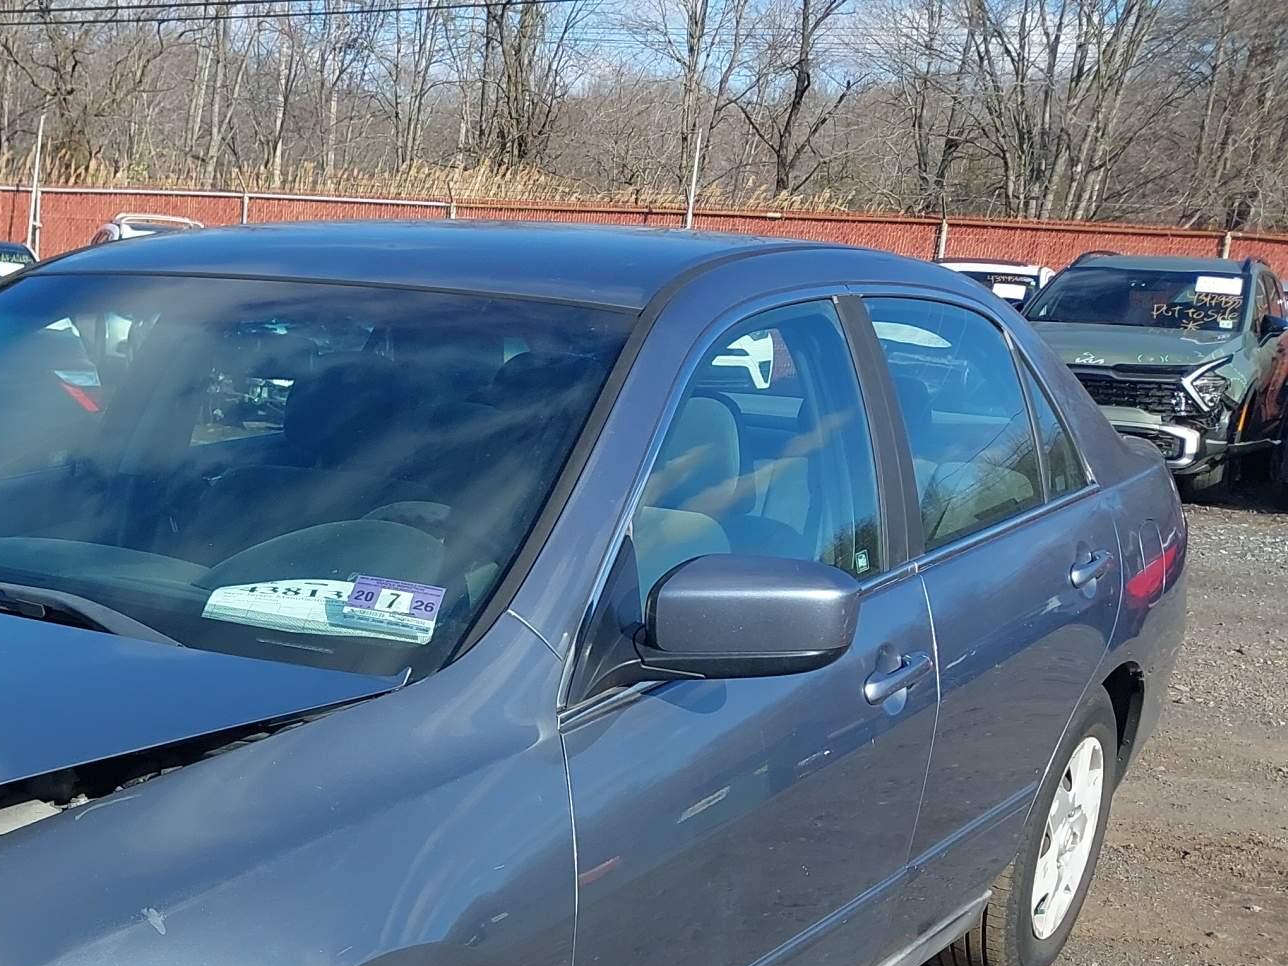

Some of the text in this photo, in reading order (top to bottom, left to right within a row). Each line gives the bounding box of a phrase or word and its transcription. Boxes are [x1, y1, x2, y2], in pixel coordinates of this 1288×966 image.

[239, 586, 351, 601] 43813
[354, 590, 375, 602] 20
[385, 592, 402, 609] 7
[413, 600, 436, 613] 26
